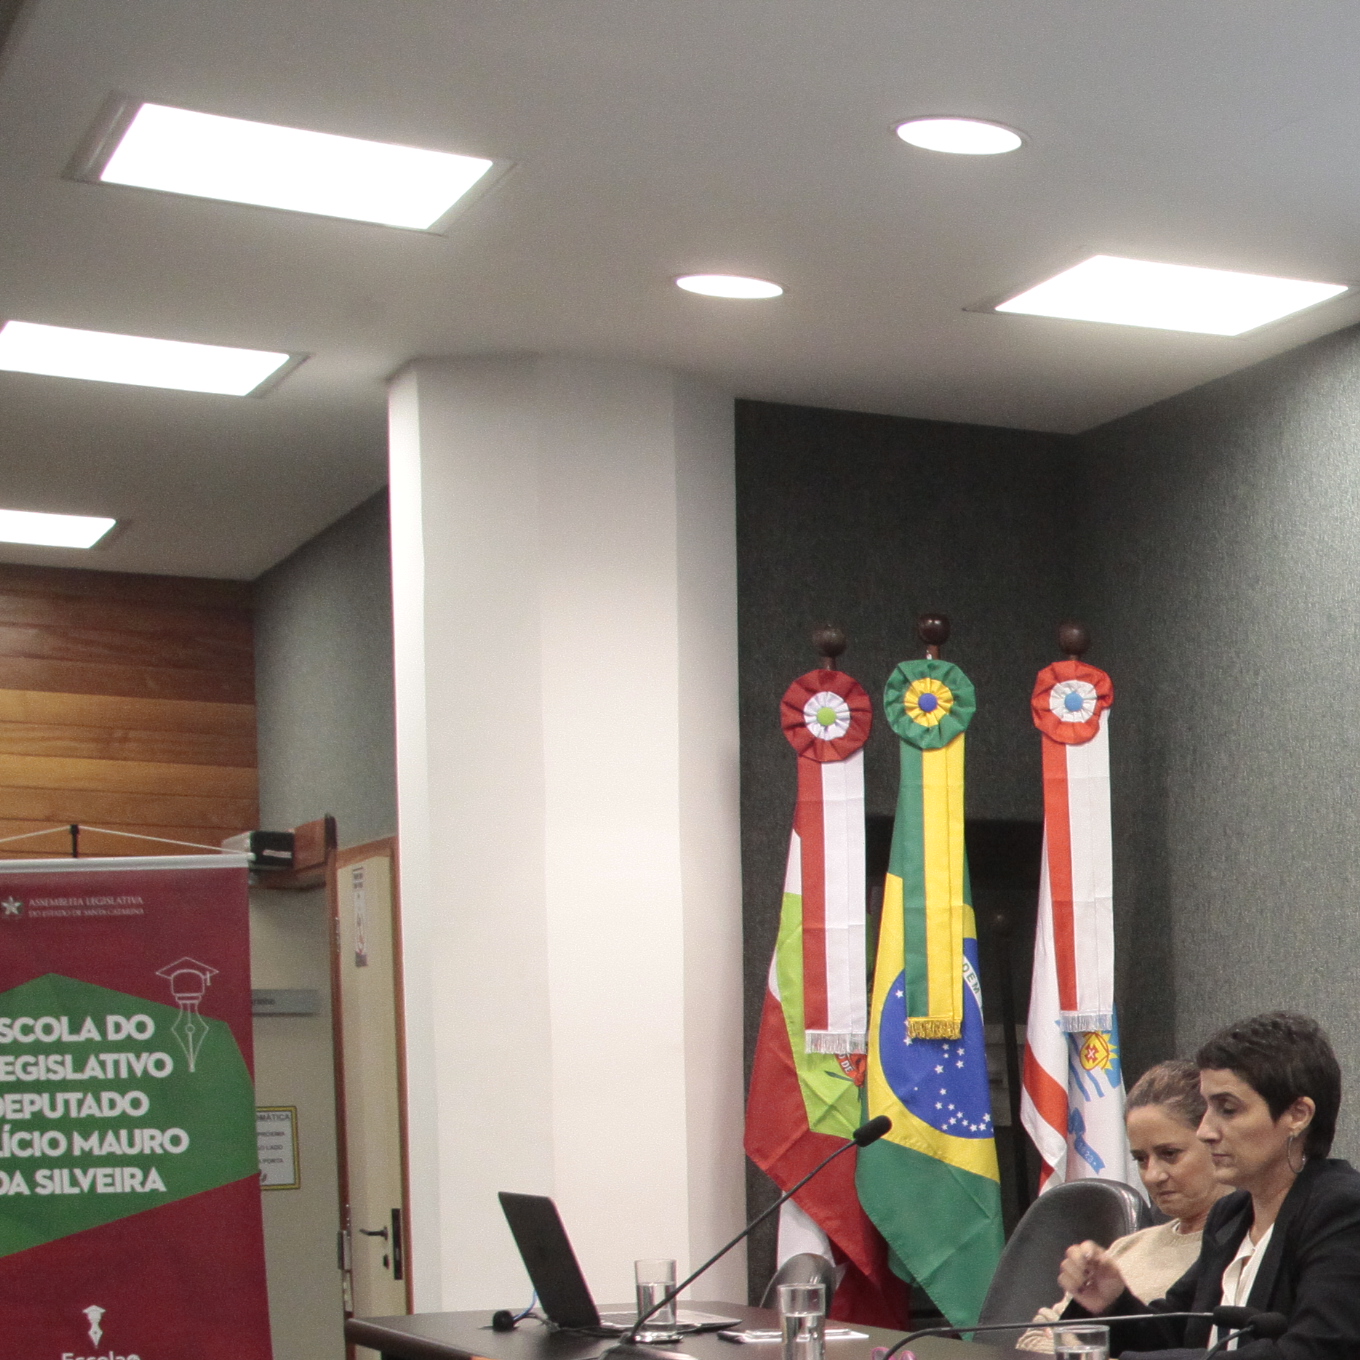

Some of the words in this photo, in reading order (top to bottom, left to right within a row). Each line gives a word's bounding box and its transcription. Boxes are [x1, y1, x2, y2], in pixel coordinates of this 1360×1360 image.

[106, 1014, 155, 1040] DO
[0, 1090, 149, 1120] EPUTADO
[0, 1124, 67, 1157] ÍCIO
[73, 1128, 190, 1156] MAURO
[34, 1167, 167, 1195] SILVEIRA
